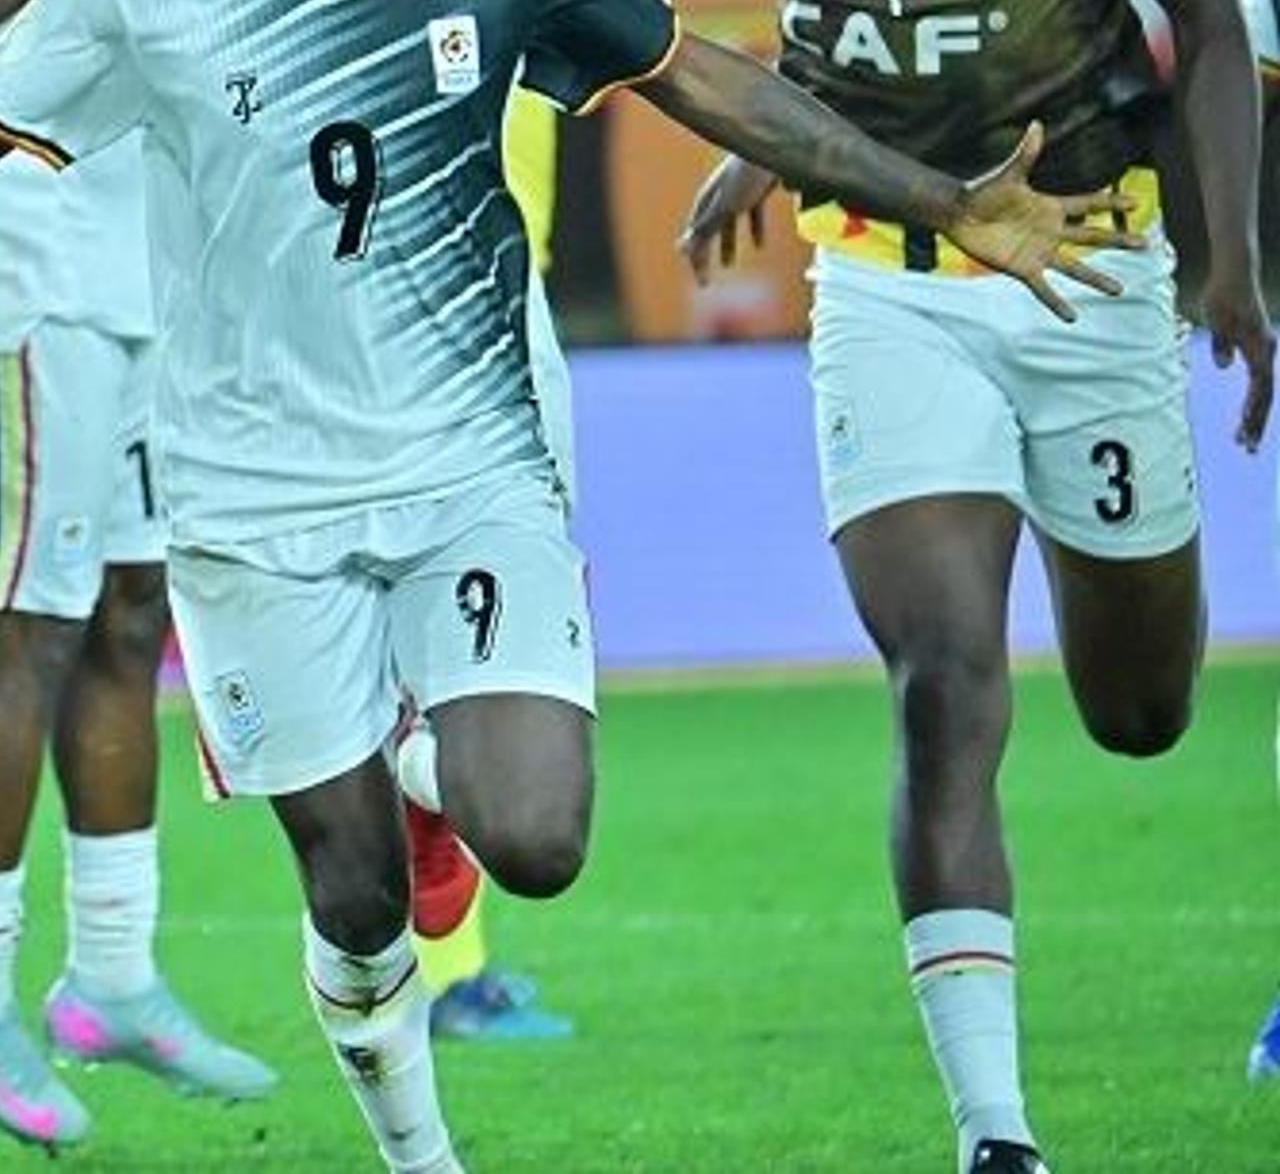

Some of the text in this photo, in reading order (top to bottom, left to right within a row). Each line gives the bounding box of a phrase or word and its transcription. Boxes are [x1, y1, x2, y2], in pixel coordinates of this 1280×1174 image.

[782, 0, 981, 75] CAF
[309, 122, 382, 262] 9
[125, 439, 168, 521] 1
[1090, 439, 1136, 524] 3
[455, 567, 504, 664] 9
